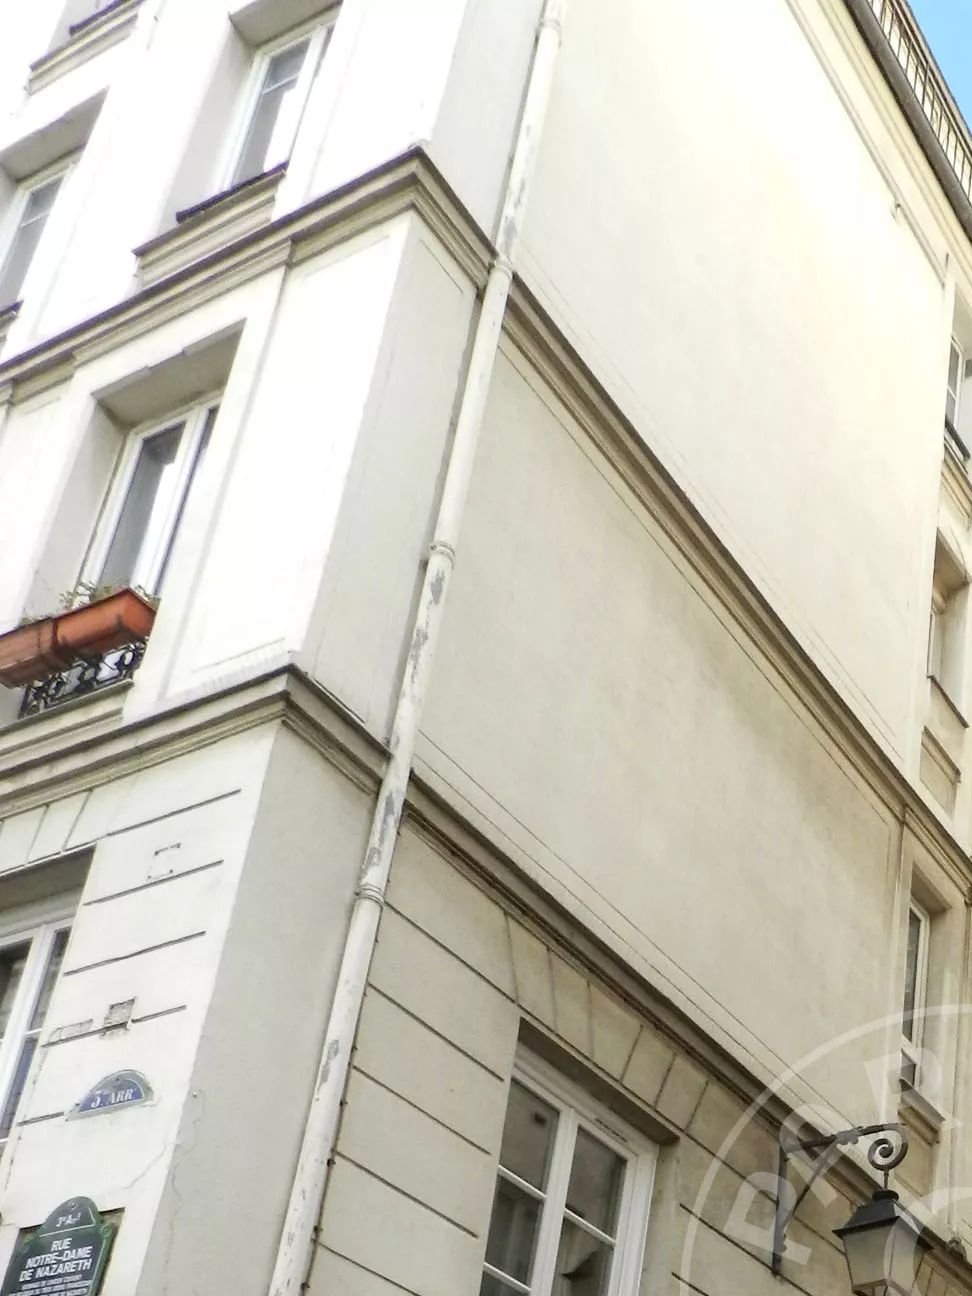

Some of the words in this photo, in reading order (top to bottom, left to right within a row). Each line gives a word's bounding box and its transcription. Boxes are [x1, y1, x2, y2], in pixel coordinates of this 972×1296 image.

[51, 1237, 72, 1252] RUE
[25, 1246, 93, 1269] NOTRE-DAME
[19, 1270, 34, 1282] DE
[36, 1259, 92, 1278] NAZARETH
